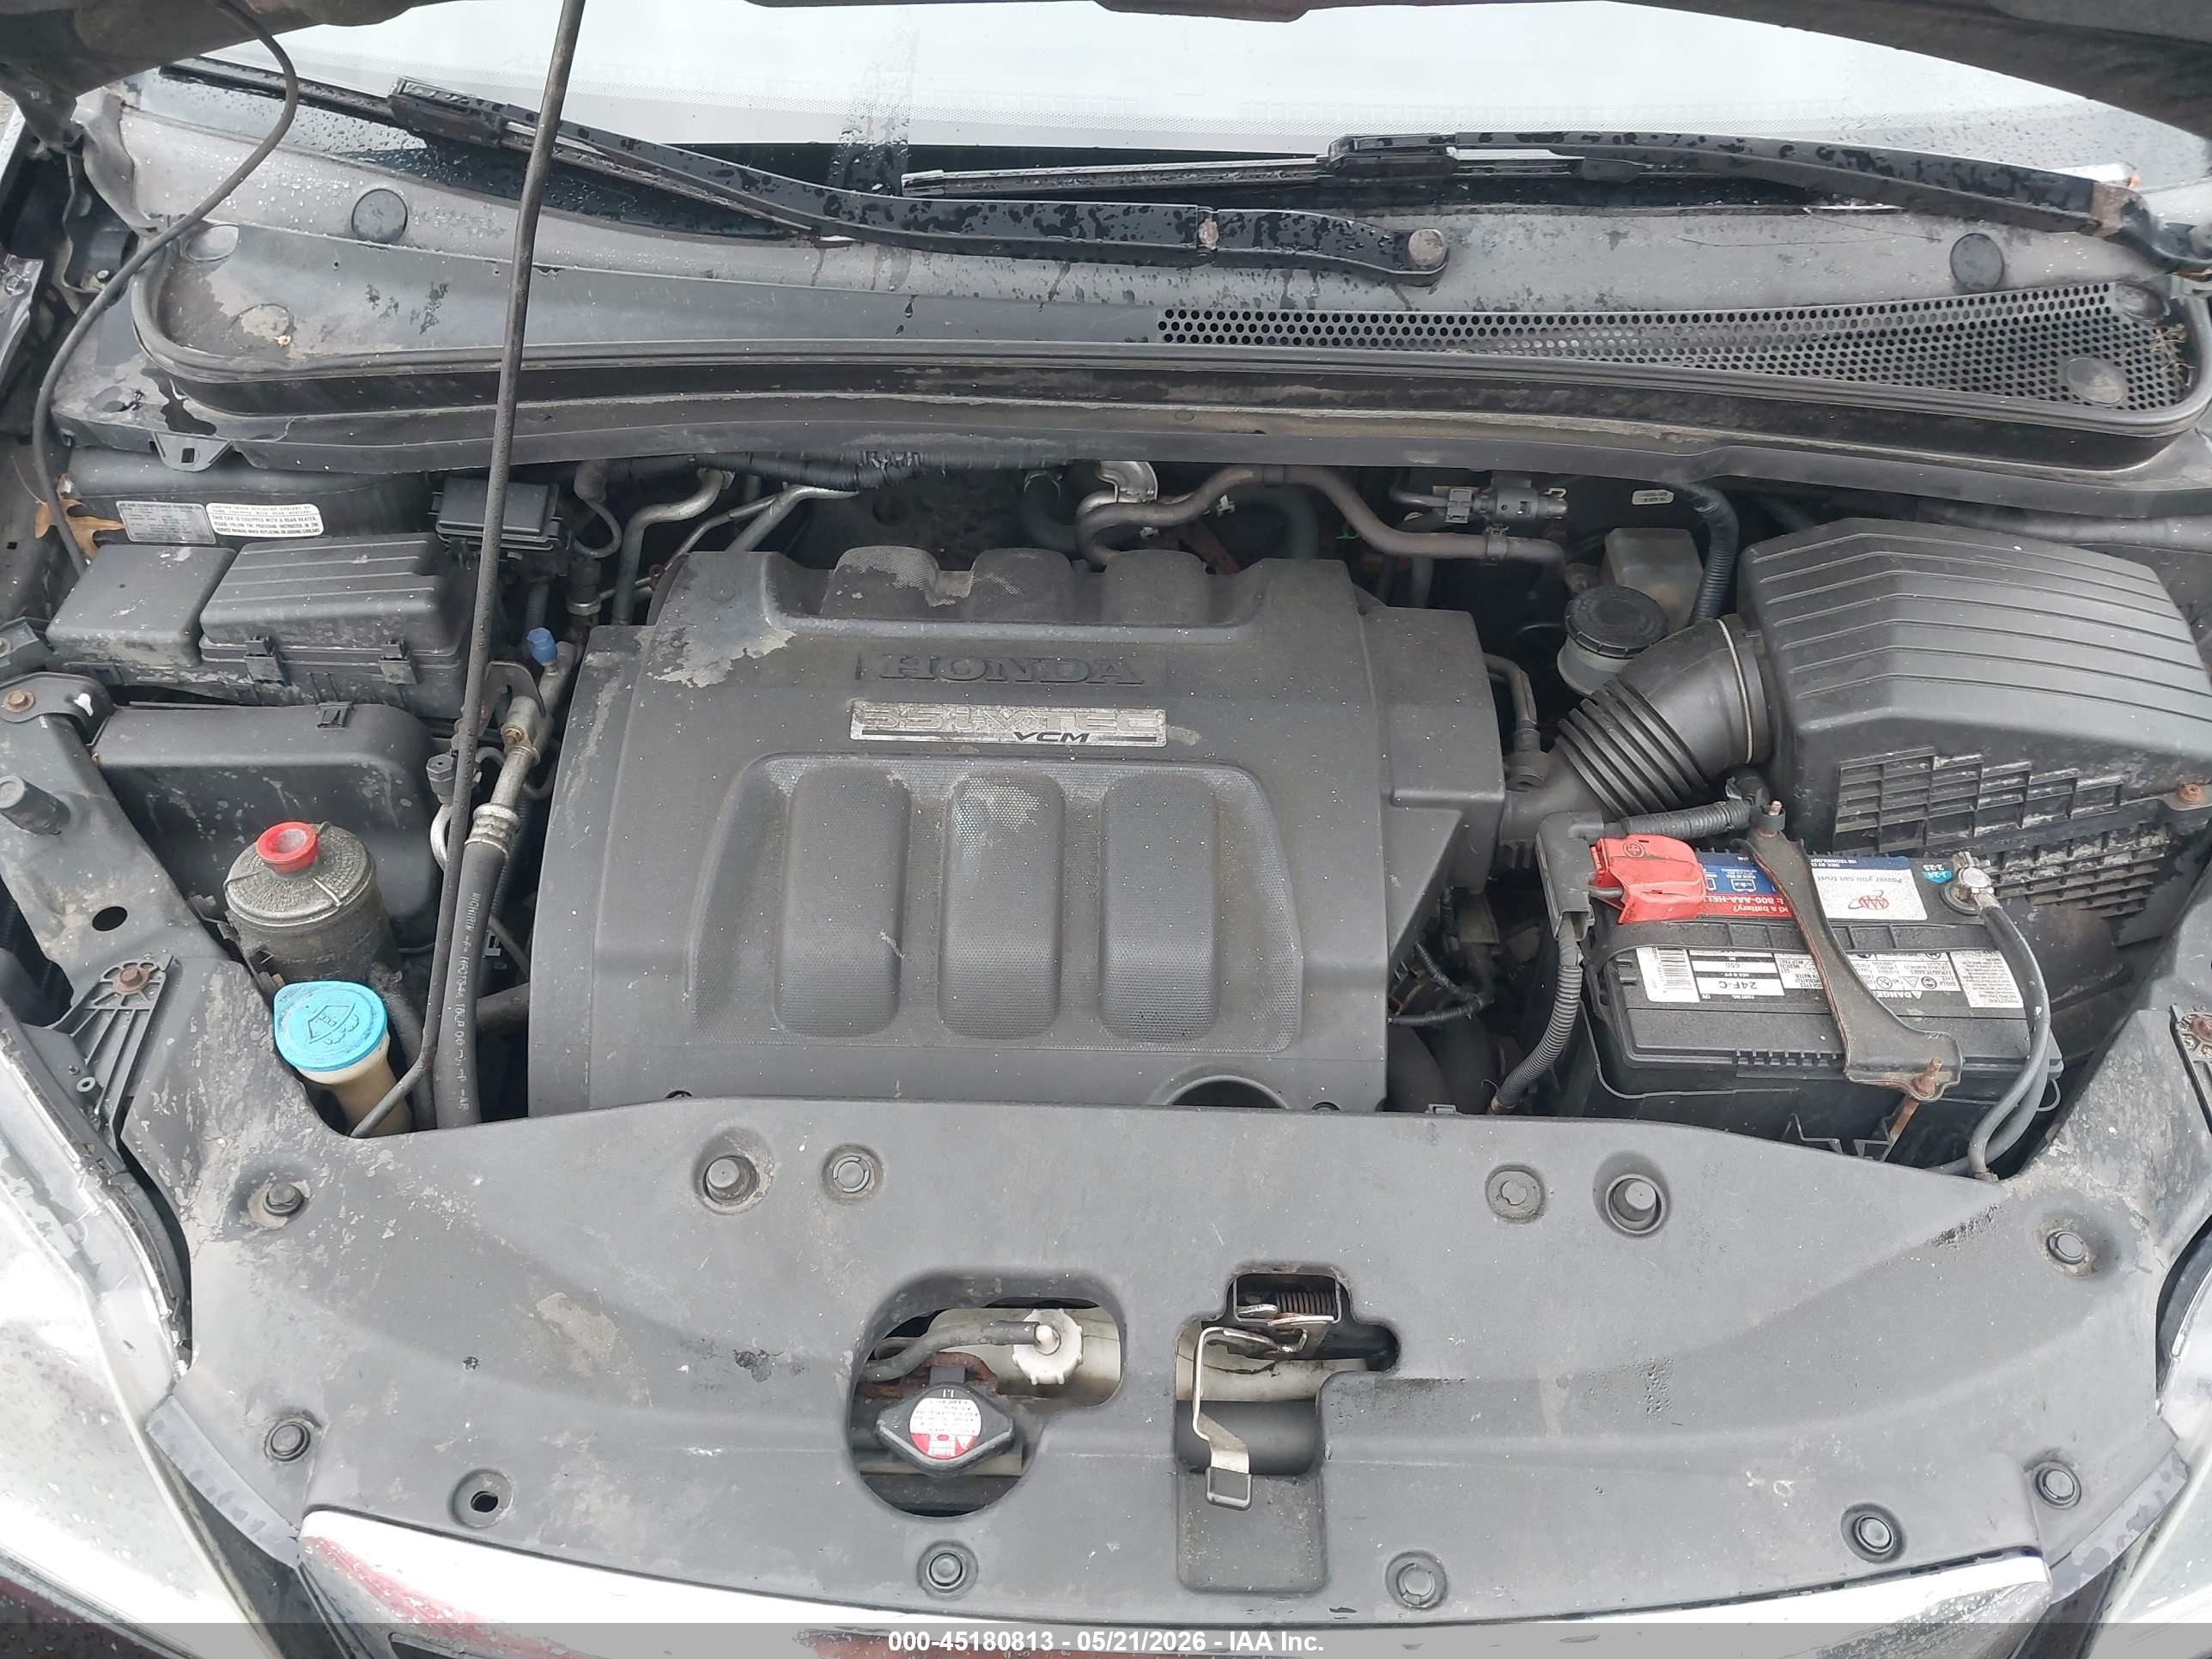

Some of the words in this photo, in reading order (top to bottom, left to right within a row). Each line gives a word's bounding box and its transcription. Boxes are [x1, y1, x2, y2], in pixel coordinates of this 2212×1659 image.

[879, 653, 1146, 686] HONDA
[1013, 731, 1091, 744] VCM
[1733, 904, 1769, 913] battery?
[1718, 981, 1758, 990] 24F-C
